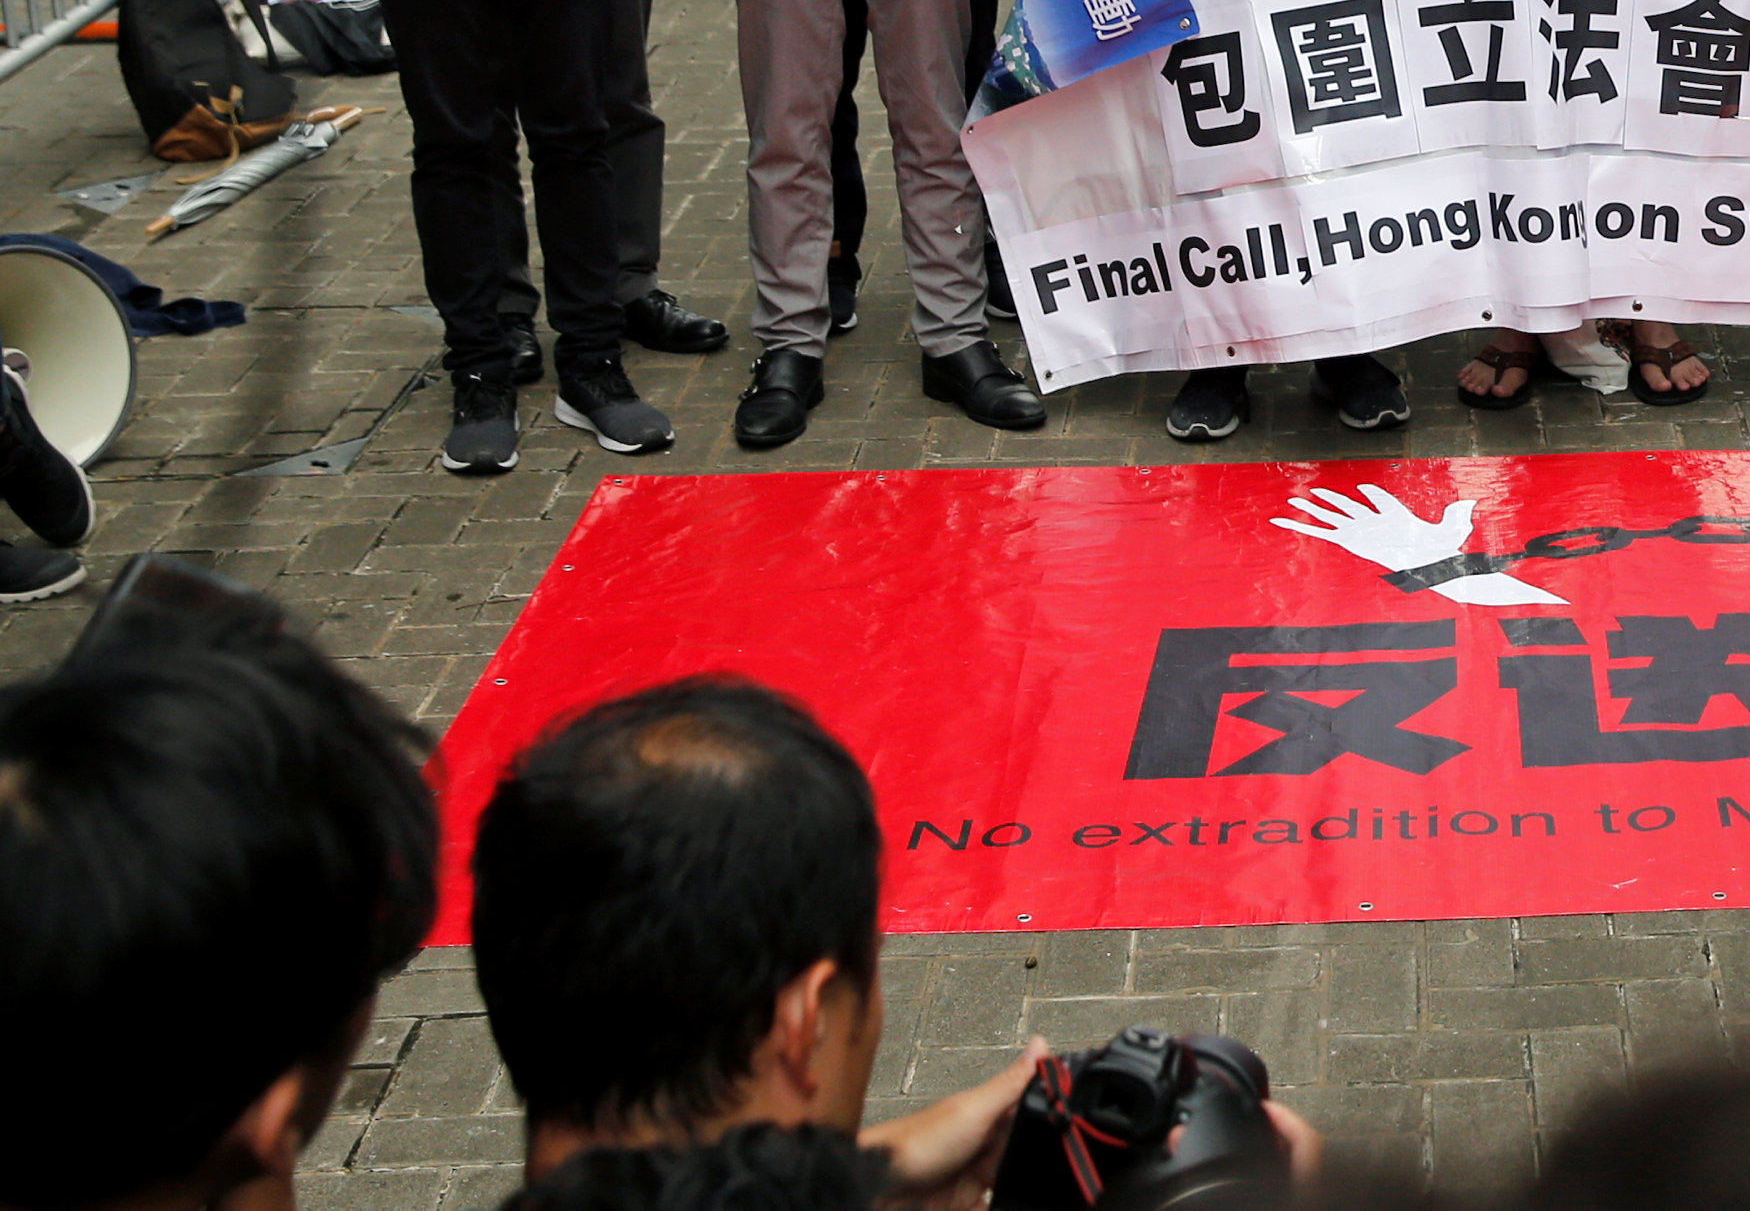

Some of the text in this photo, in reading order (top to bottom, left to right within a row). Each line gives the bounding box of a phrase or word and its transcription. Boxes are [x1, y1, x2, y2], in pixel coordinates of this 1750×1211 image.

[1030, 242, 1173, 315] Final
[1178, 223, 1311, 285] Call,
[1313, 199, 1482, 267] Hong
[1594, 201, 1679, 243] on
[905, 818, 1032, 852] No
[1071, 805, 1557, 851] extradition
[1594, 802, 1677, 834] to
